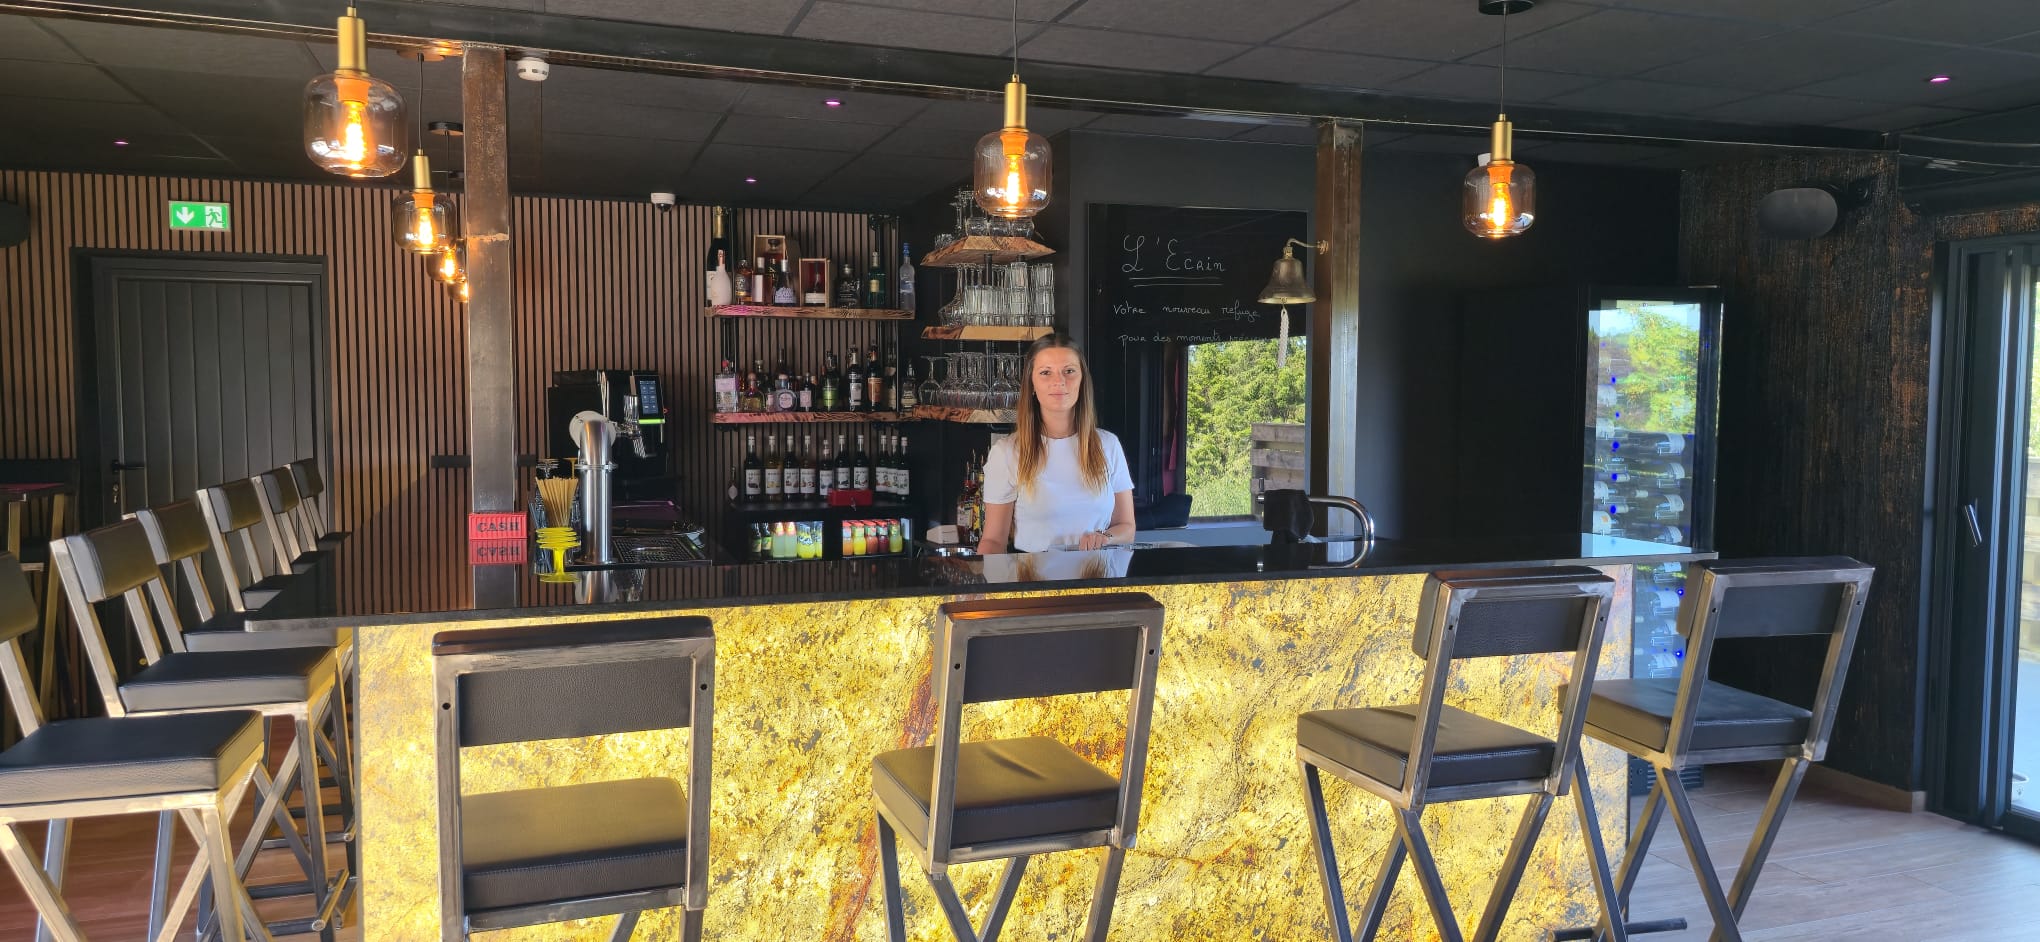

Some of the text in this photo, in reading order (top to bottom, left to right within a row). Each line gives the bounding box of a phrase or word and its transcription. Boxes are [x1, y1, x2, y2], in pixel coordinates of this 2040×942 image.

[1112, 299, 1261, 322] Votre nouveau refuge
[1153, 330, 1171, 343] des
[477, 522, 520, 532] CASH
